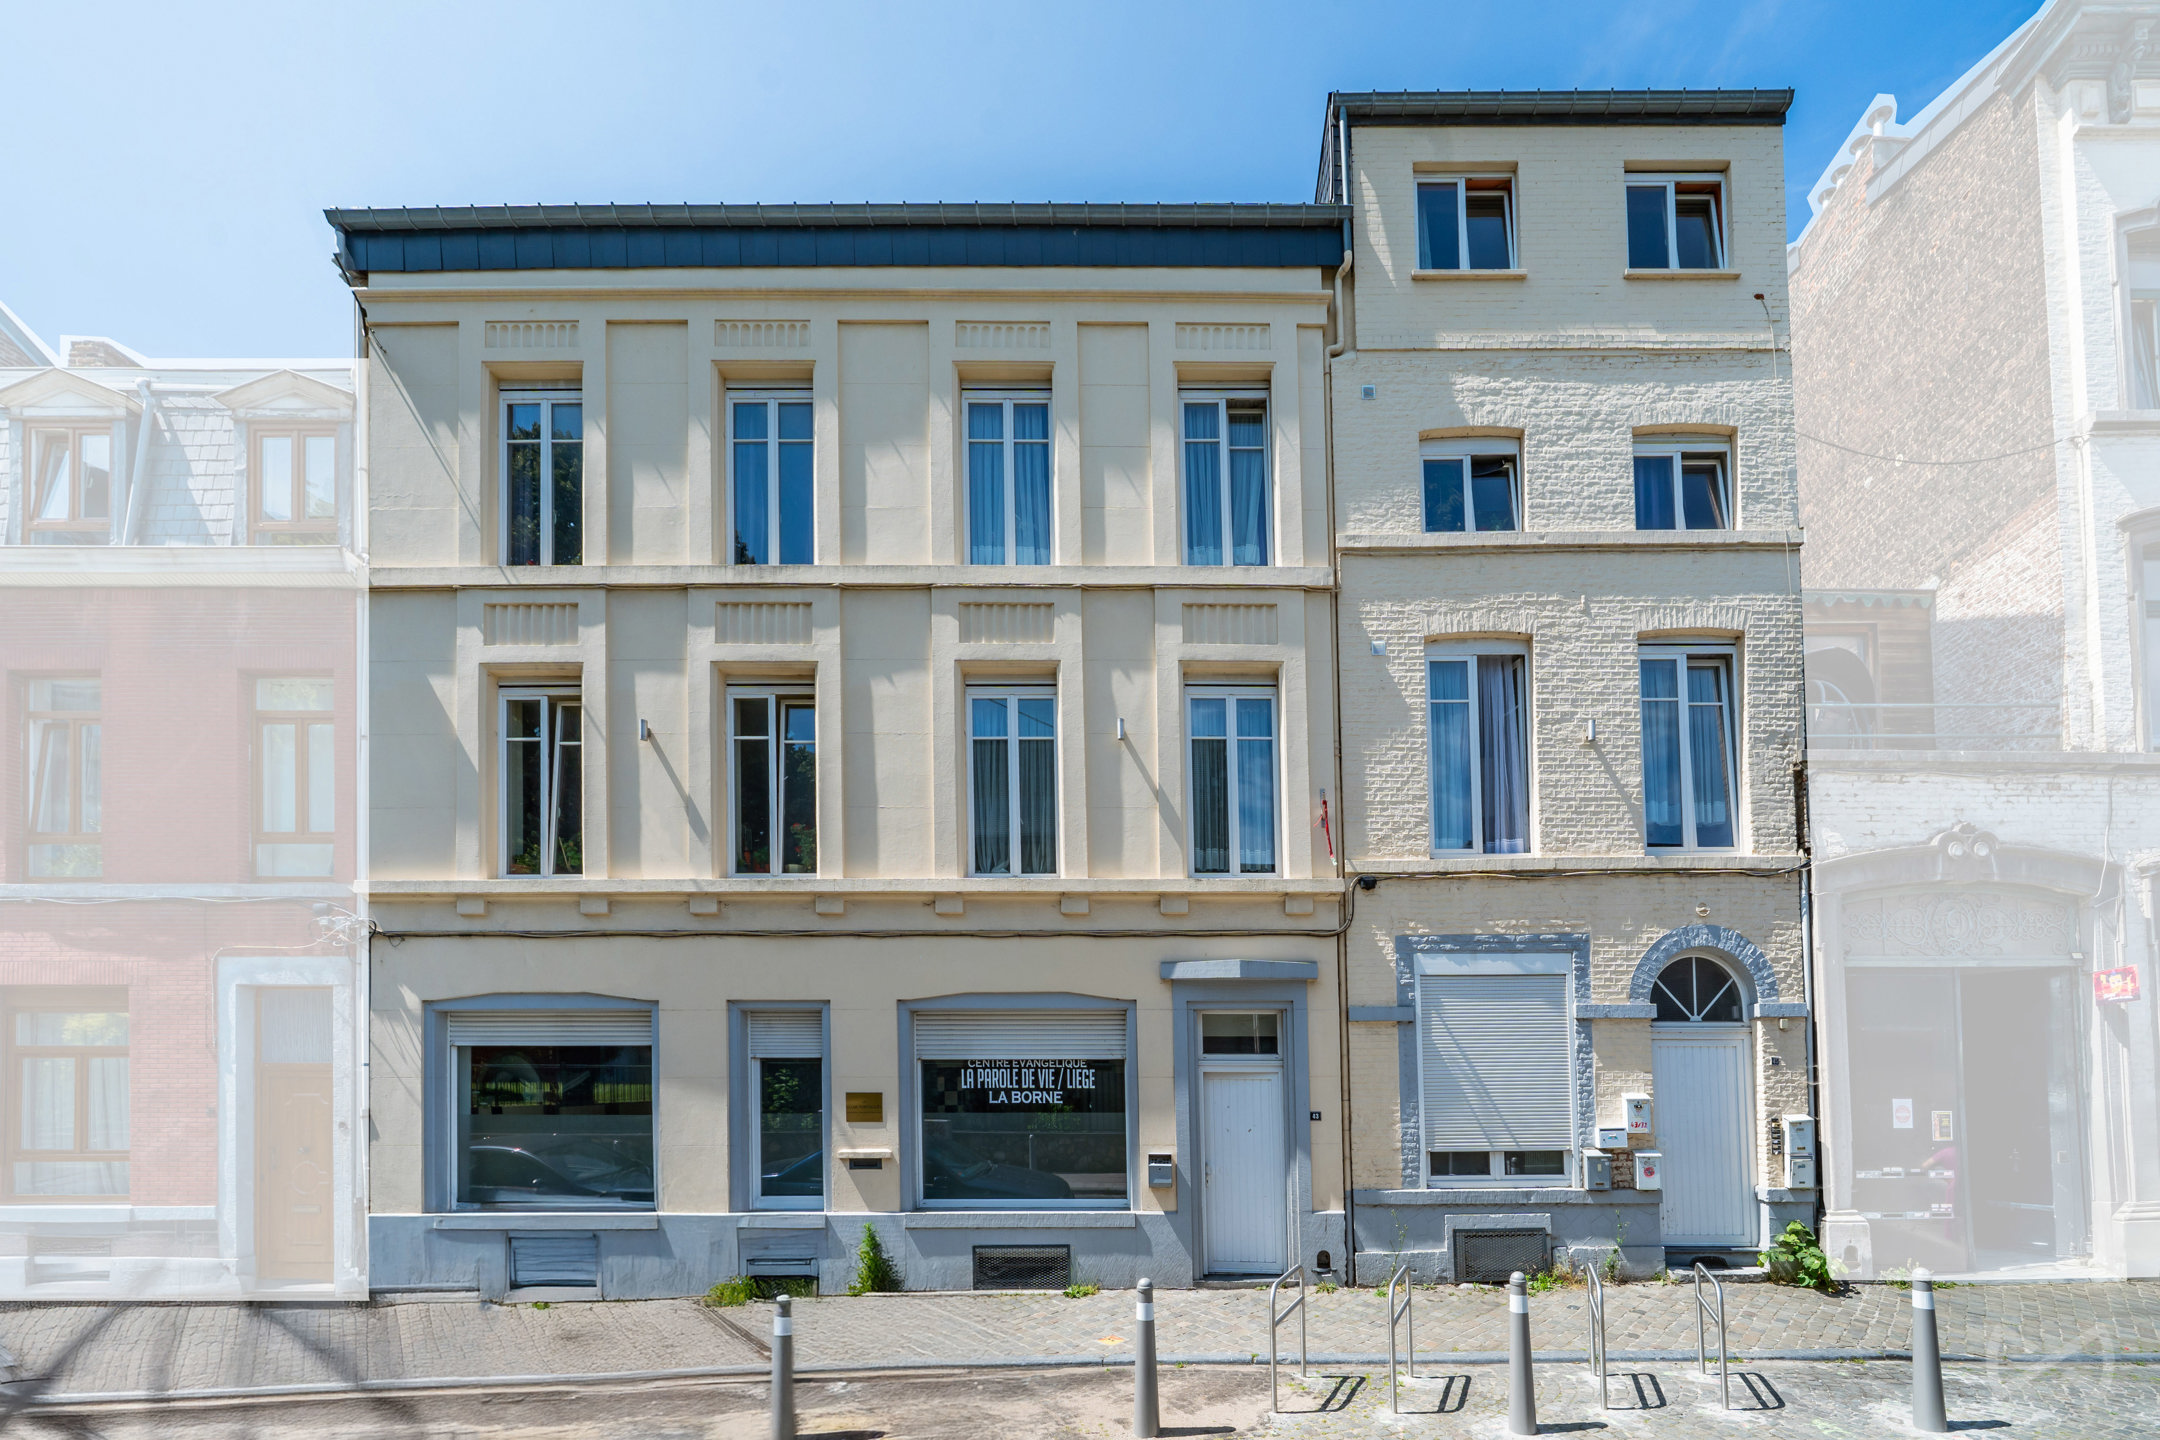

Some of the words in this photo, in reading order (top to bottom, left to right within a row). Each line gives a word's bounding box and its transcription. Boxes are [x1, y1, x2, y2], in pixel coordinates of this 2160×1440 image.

[967, 1059, 1011, 1068] CENTRE
[961, 1068, 974, 1089] LA
[977, 1068, 1019, 1089] PAROLE
[1021, 1068, 1036, 1089] DE
[1038, 1068, 1055, 1089] VIE
[1057, 1067, 1064, 1090] /
[1067, 1068, 1096, 1089] LIEGE
[989, 1090, 1008, 1104] LA
[1011, 1090, 1064, 1104] BORNE
